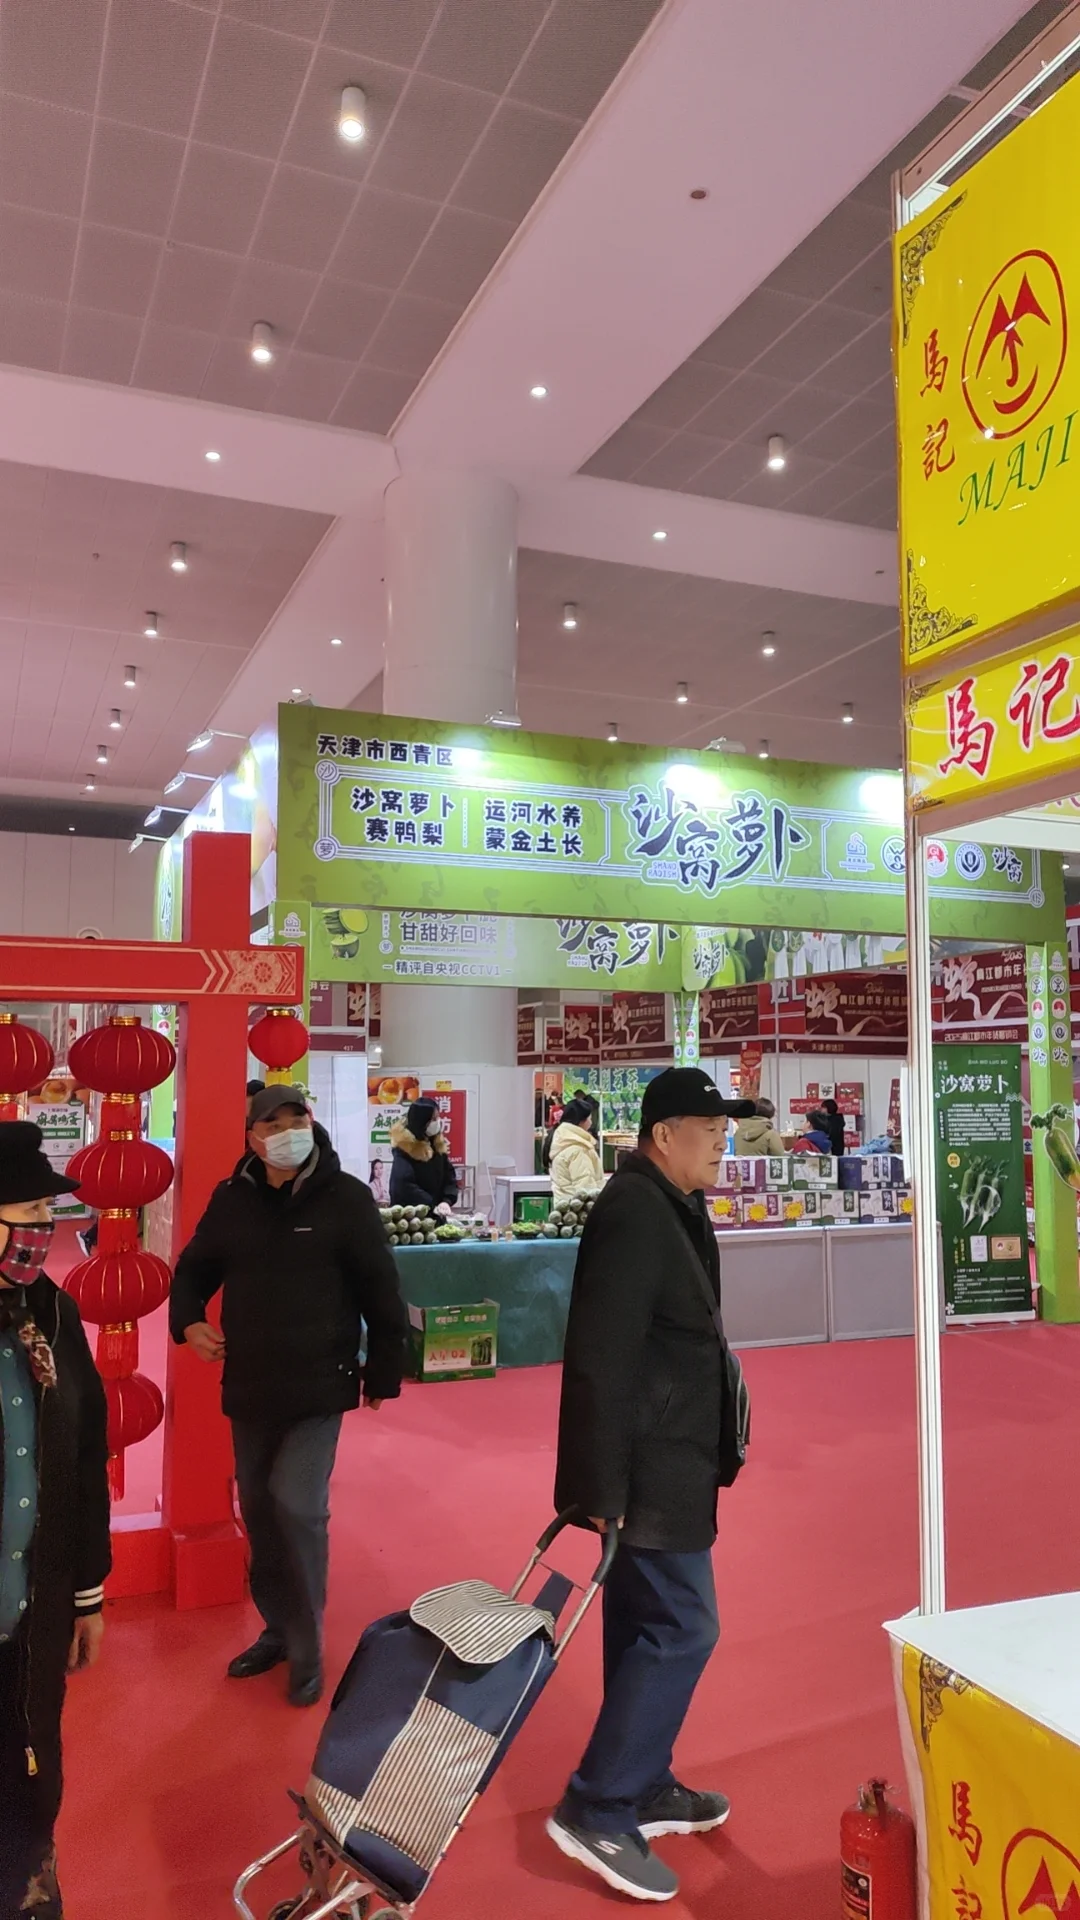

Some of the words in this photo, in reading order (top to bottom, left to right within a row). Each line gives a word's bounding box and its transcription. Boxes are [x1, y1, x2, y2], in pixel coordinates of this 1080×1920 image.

[957, 409, 1079, 526] MAJI
[317, 734, 455, 767] 天津市西青区
[350, 786, 455, 820] 沙窝萝卜
[485, 800, 582, 828] 运河水养
[365, 817, 444, 847] 赛鸭梨
[484, 826, 583, 858] 蒙金土长
[631, 786, 804, 890] 沙窝萝卜
[400, 922, 498, 944] 甘甜好回味
[940, 1073, 1010, 1095] 沙窝萝卜
